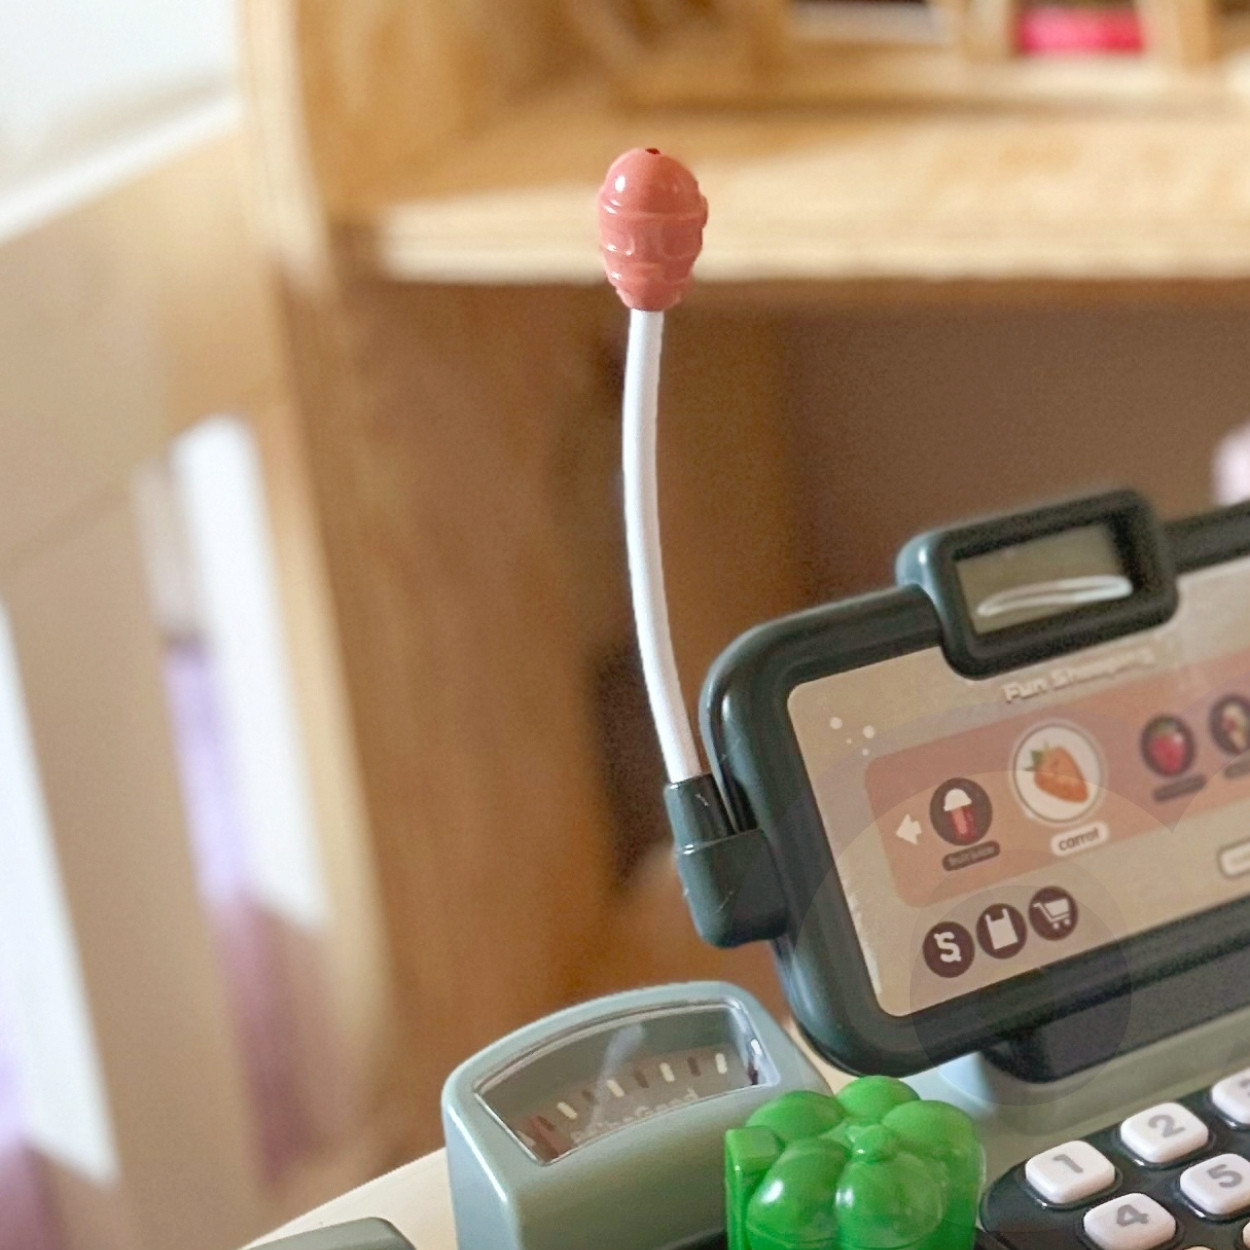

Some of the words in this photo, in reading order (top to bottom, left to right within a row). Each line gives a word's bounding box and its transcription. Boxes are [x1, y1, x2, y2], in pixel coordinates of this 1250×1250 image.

[1003, 678, 1047, 702] Fun
[1058, 826, 1100, 852] carrot
[1147, 1113, 1186, 1139] 2
[1053, 1153, 1084, 1175] 1
[1207, 1163, 1243, 1188] 5
[1116, 1203, 1149, 1228] 4
